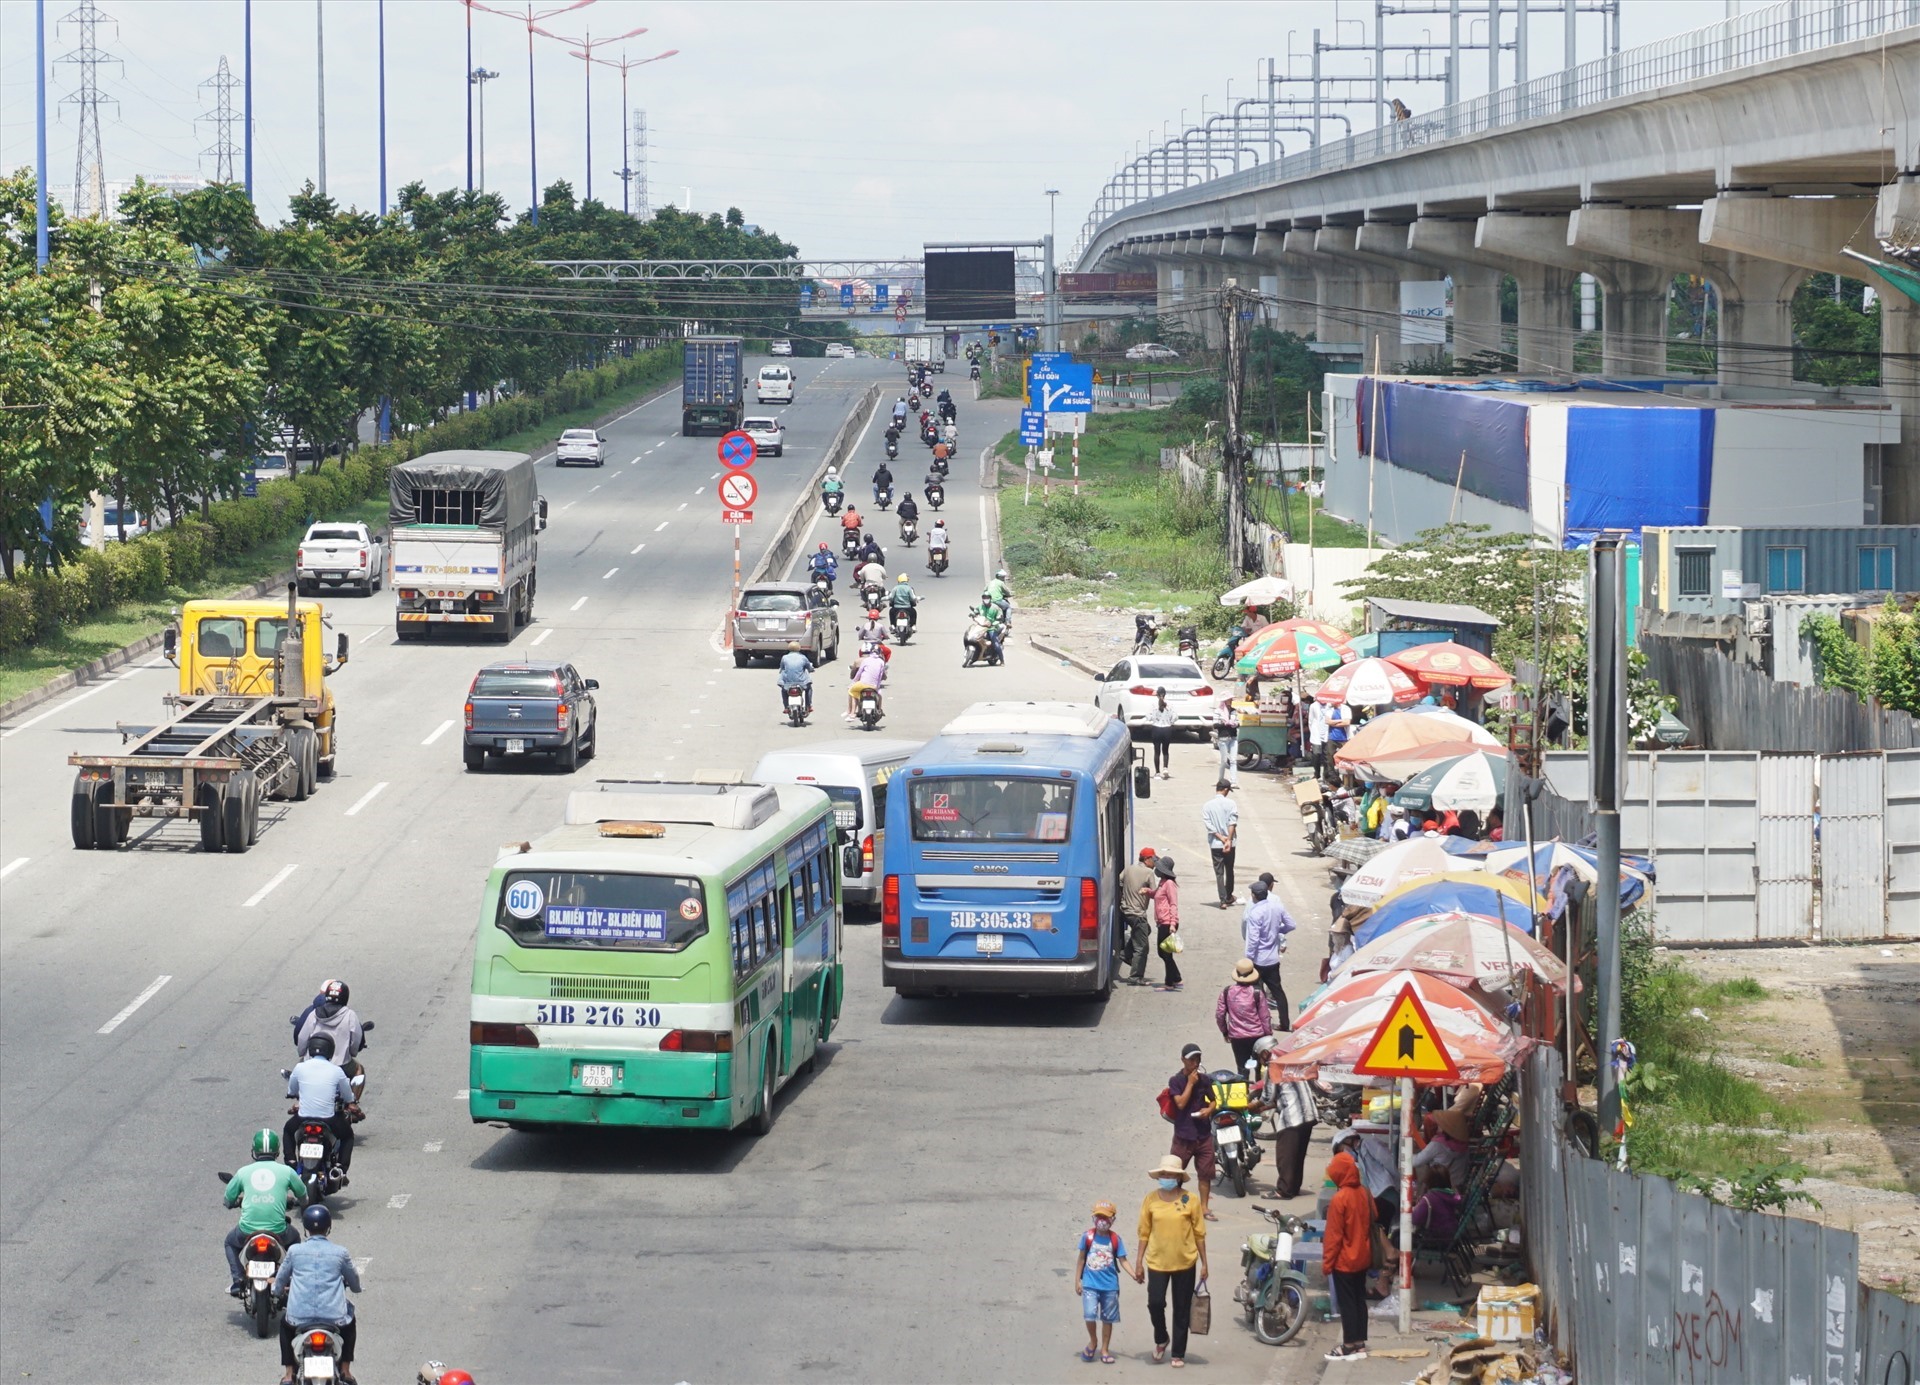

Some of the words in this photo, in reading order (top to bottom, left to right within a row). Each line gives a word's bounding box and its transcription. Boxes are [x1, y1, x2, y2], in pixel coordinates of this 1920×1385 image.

[973, 865, 1009, 873] SAMCO
[1355, 875, 1386, 887] VEDAN
[510, 890, 538, 910] 601
[587, 910, 603, 926] TÂY
[643, 912, 662, 929] HÒA
[950, 912, 1031, 928] 51B-305.33
[537, 1004, 575, 1024] 51B
[585, 1005, 624, 1026] 276
[635, 1007, 661, 1027] 30
[589, 1066, 606, 1076] 51B
[251, 1194, 275, 1204] Grab
